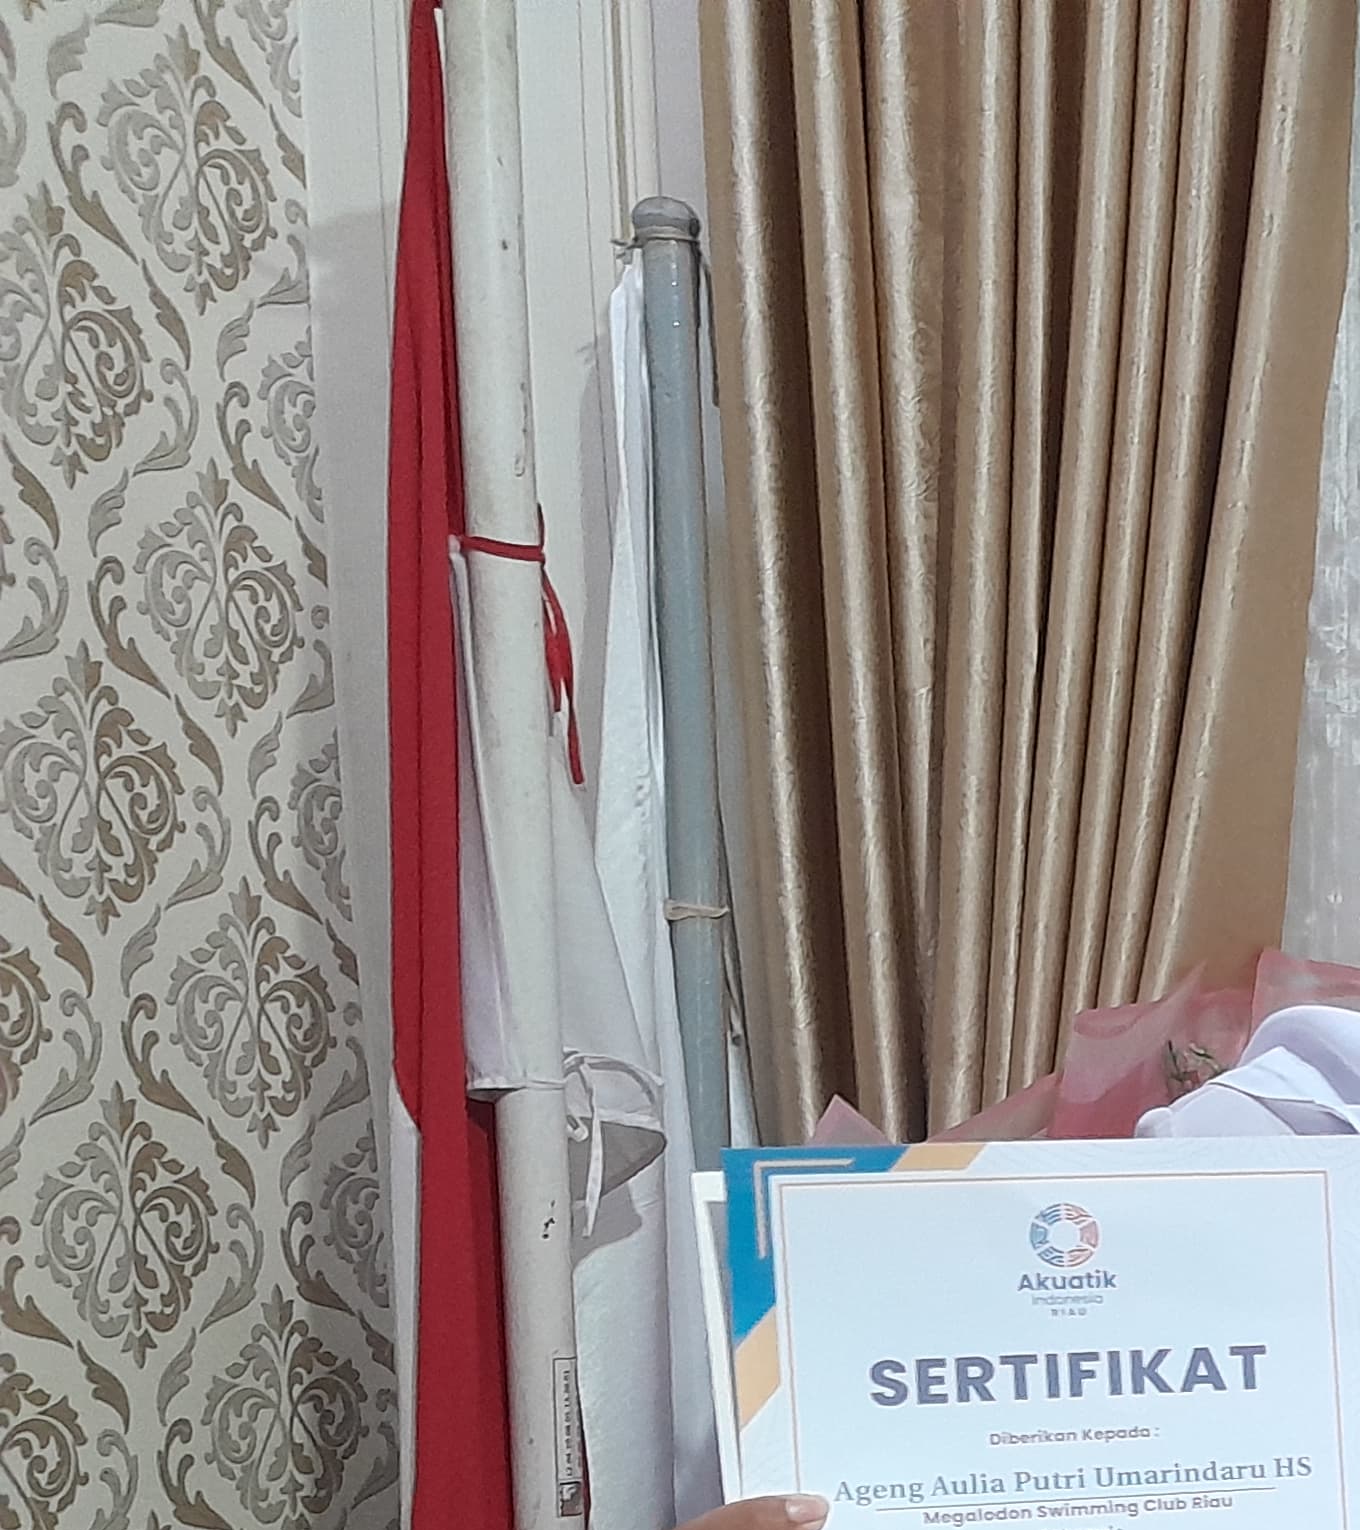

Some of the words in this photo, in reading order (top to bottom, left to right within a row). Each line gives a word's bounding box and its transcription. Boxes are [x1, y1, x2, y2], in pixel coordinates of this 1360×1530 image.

[1017, 1270, 1118, 1291] Akuatik
[869, 1344, 1267, 1407] SERTIFIKAT
[990, 1428, 1077, 1446] Diberikan
[834, 1480, 925, 1506] Ageng
[931, 1473, 1006, 1496] Aulia
[1014, 1468, 1086, 1492] Putri
[1095, 1461, 1266, 1488] Umarindaru
[1273, 1456, 1312, 1478] HS
[923, 1508, 1032, 1527] Megalodon
[1037, 1500, 1139, 1519] Swimming
[1144, 1497, 1187, 1512] Club
[1192, 1494, 1233, 1509] Riau
